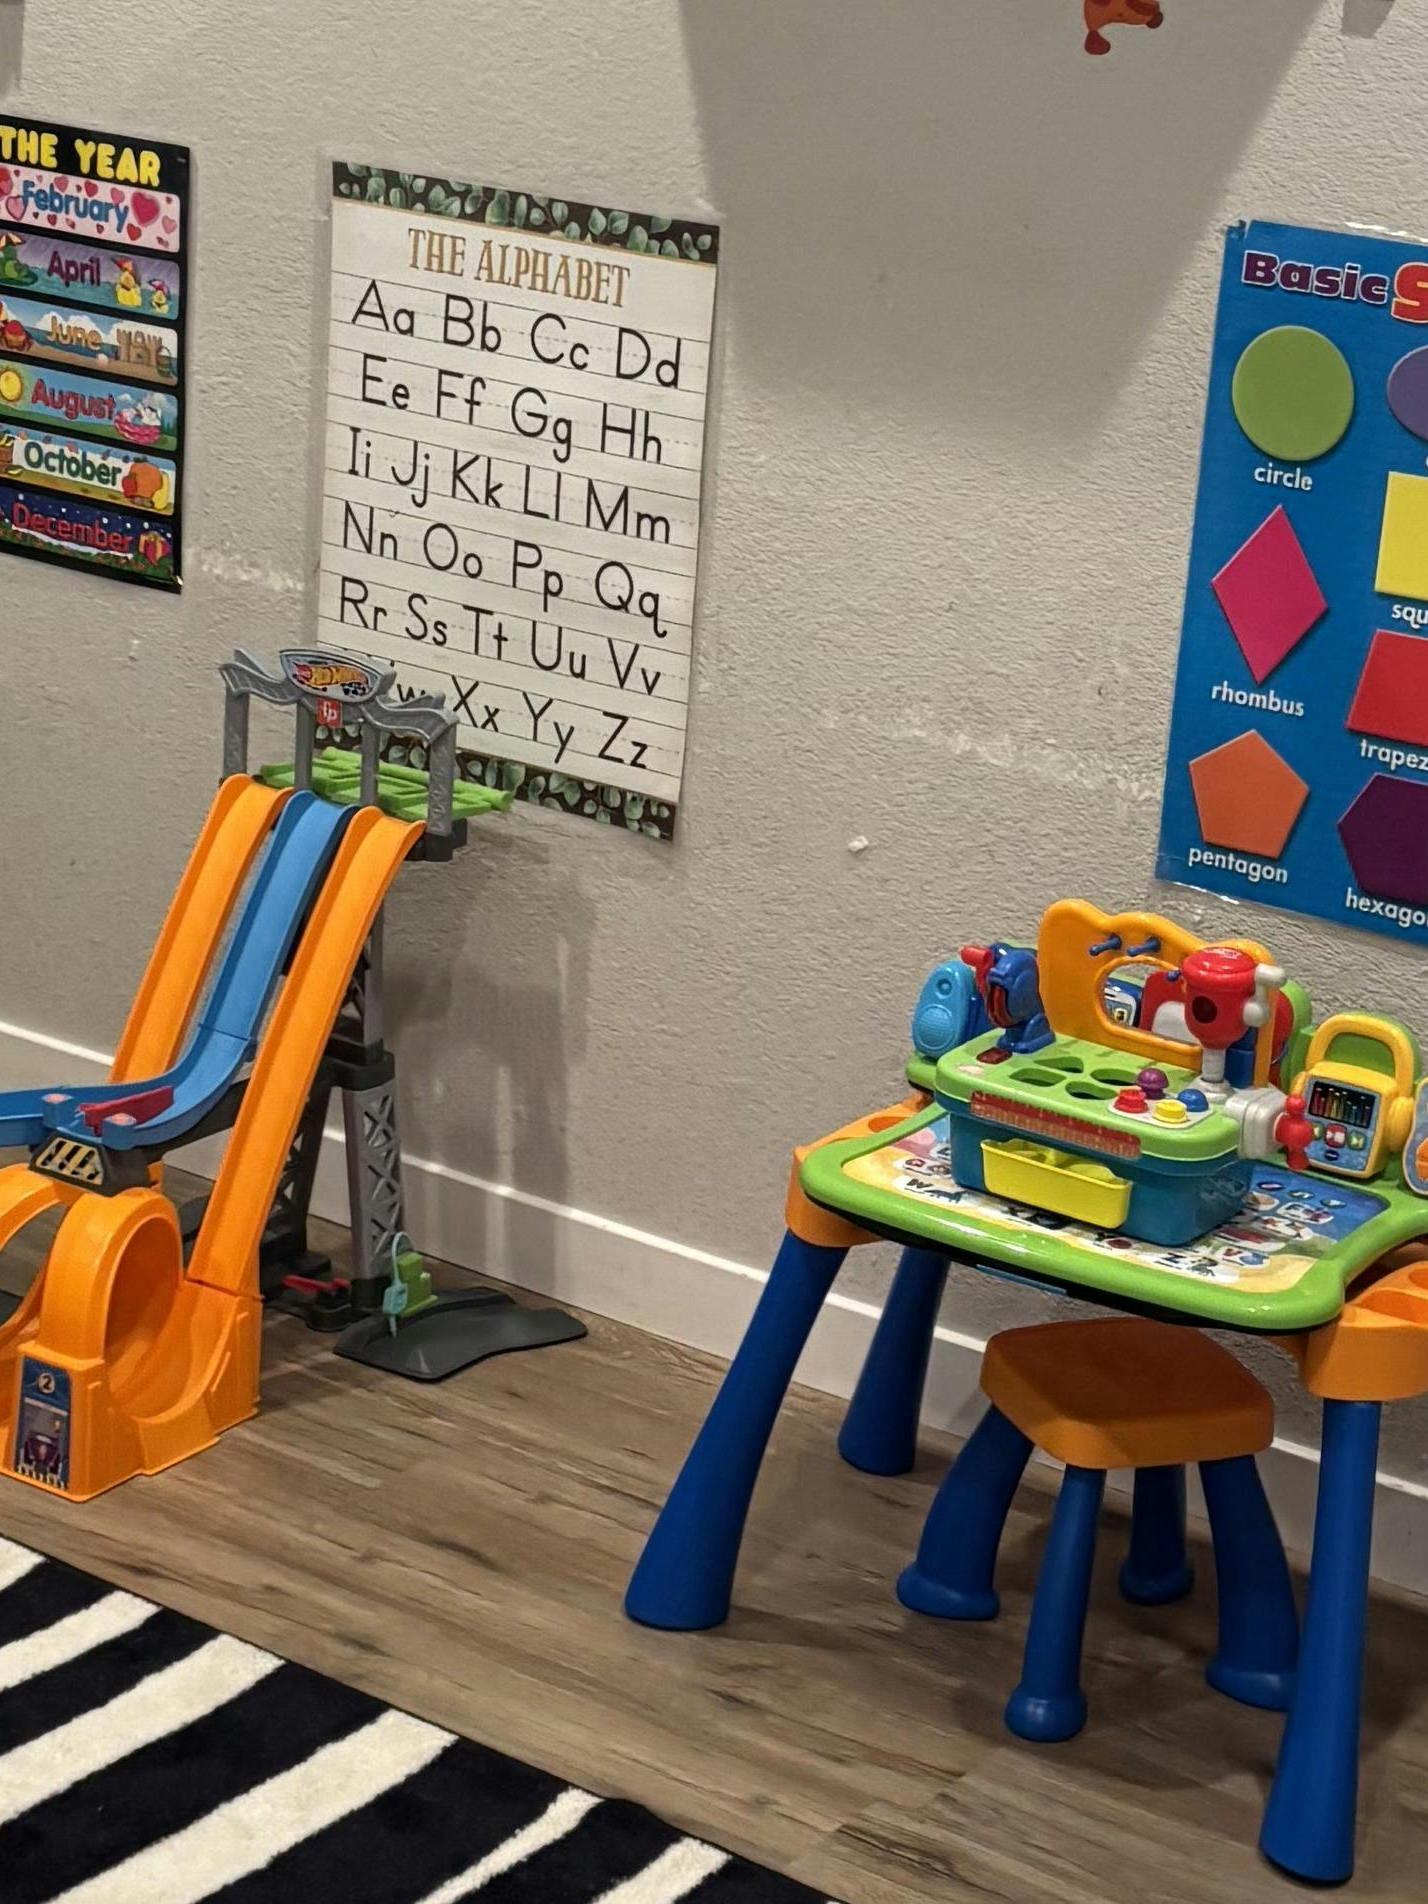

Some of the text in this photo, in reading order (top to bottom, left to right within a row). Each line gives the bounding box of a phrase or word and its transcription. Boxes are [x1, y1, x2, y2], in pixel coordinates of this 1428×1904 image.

[74, 139, 161, 188] YEAR
[21, 180, 129, 232] February
[48, 250, 100, 288] April
[408, 228, 630, 308] THE ALPHABET
[1242, 249, 1390, 305] Basic
[45, 315, 102, 352] June
[351, 280, 680, 388] Aa Bb Cc Dd
[32, 379, 117, 419] August
[362, 354, 663, 465] Ee Ff Gg Hh
[24, 440, 122, 486] October
[347, 426, 672, 545] Ii Jj Kk Ll Mm
[1253, 462, 1314, 493] circle
[12, 502, 132, 554] December
[342, 500, 668, 638] Nn Oo Pp Qq
[339, 578, 662, 695] Rr Ss Tt Uu Vv
[451, 674, 500, 734] Xx
[522, 691, 576, 765] Yy
[598, 710, 649, 771] Zz
[1210, 681, 1305, 719] rhombus
[1187, 844, 1289, 885] pentagon
[42, 1375, 52, 1392] 2
